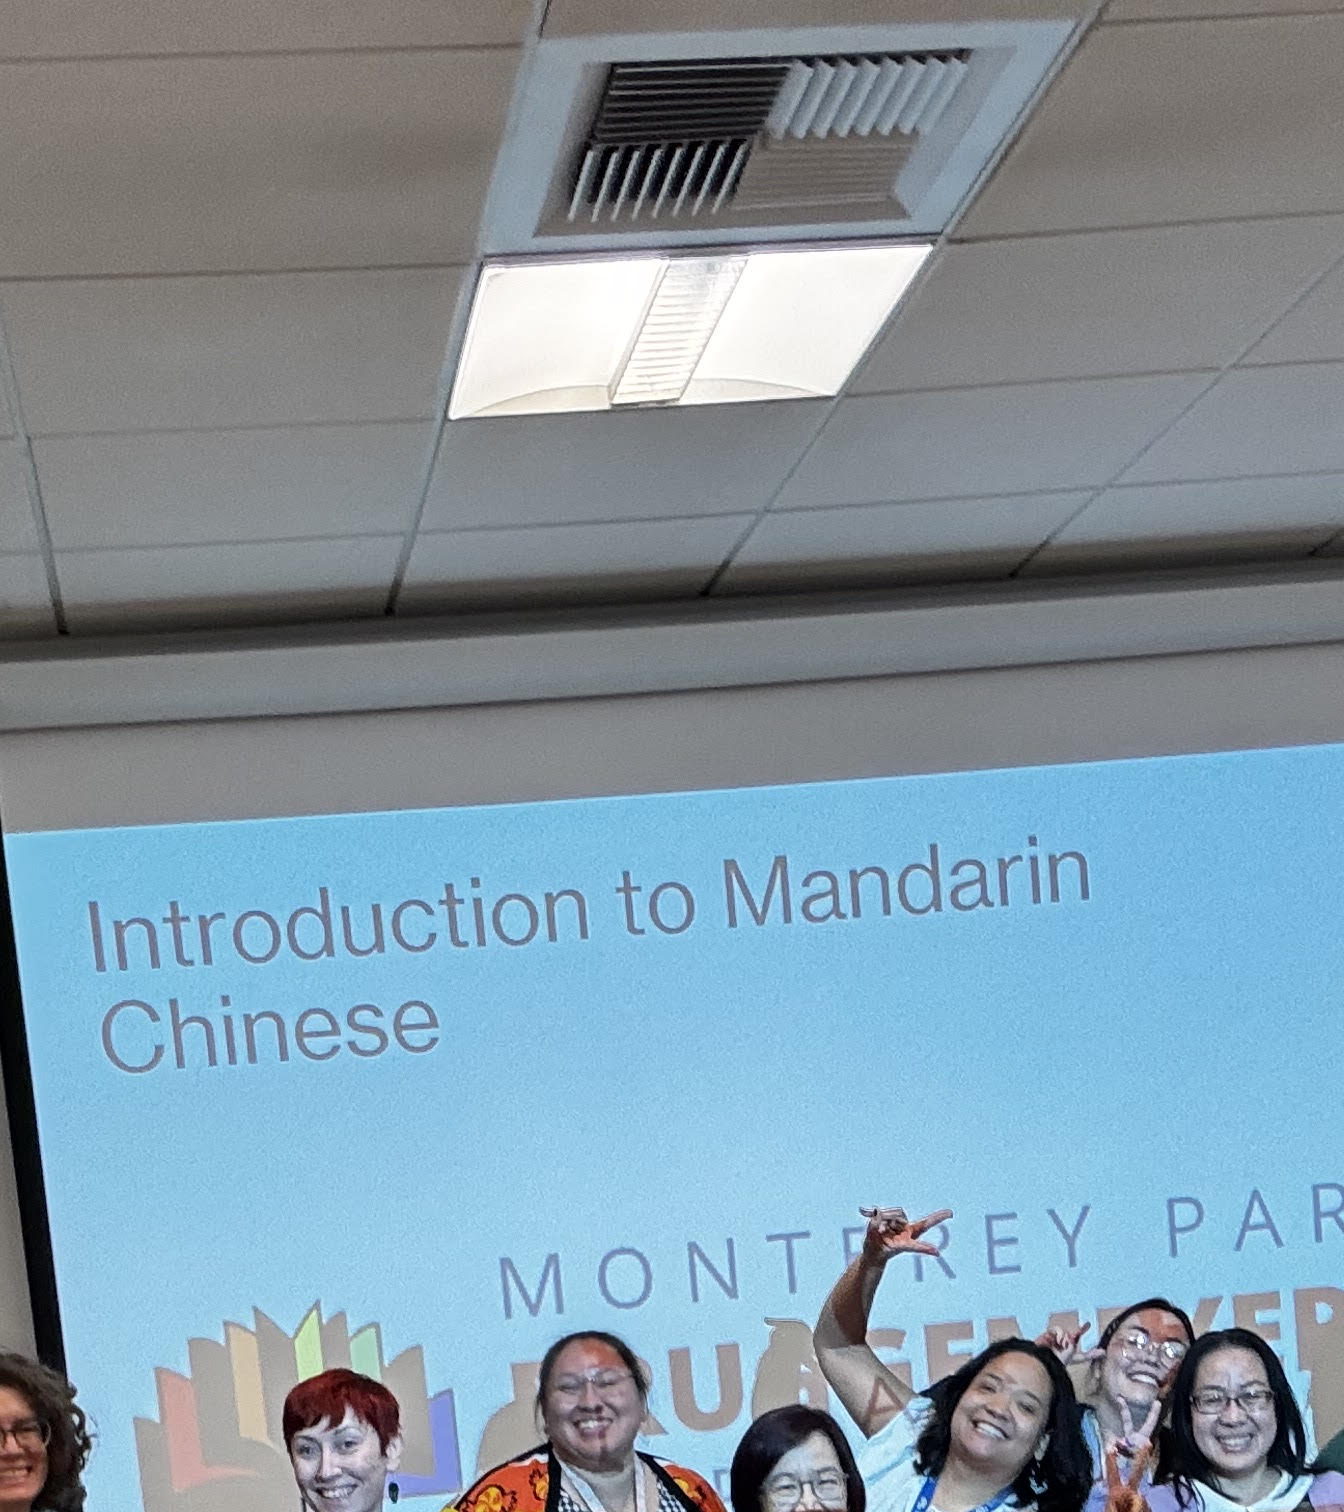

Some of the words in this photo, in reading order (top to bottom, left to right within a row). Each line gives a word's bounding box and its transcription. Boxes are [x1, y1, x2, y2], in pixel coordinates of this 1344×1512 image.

[87, 876, 590, 973] Introduction
[615, 870, 696, 936] to
[722, 835, 1091, 928] Mandarin
[102, 995, 440, 1074] Chinese
